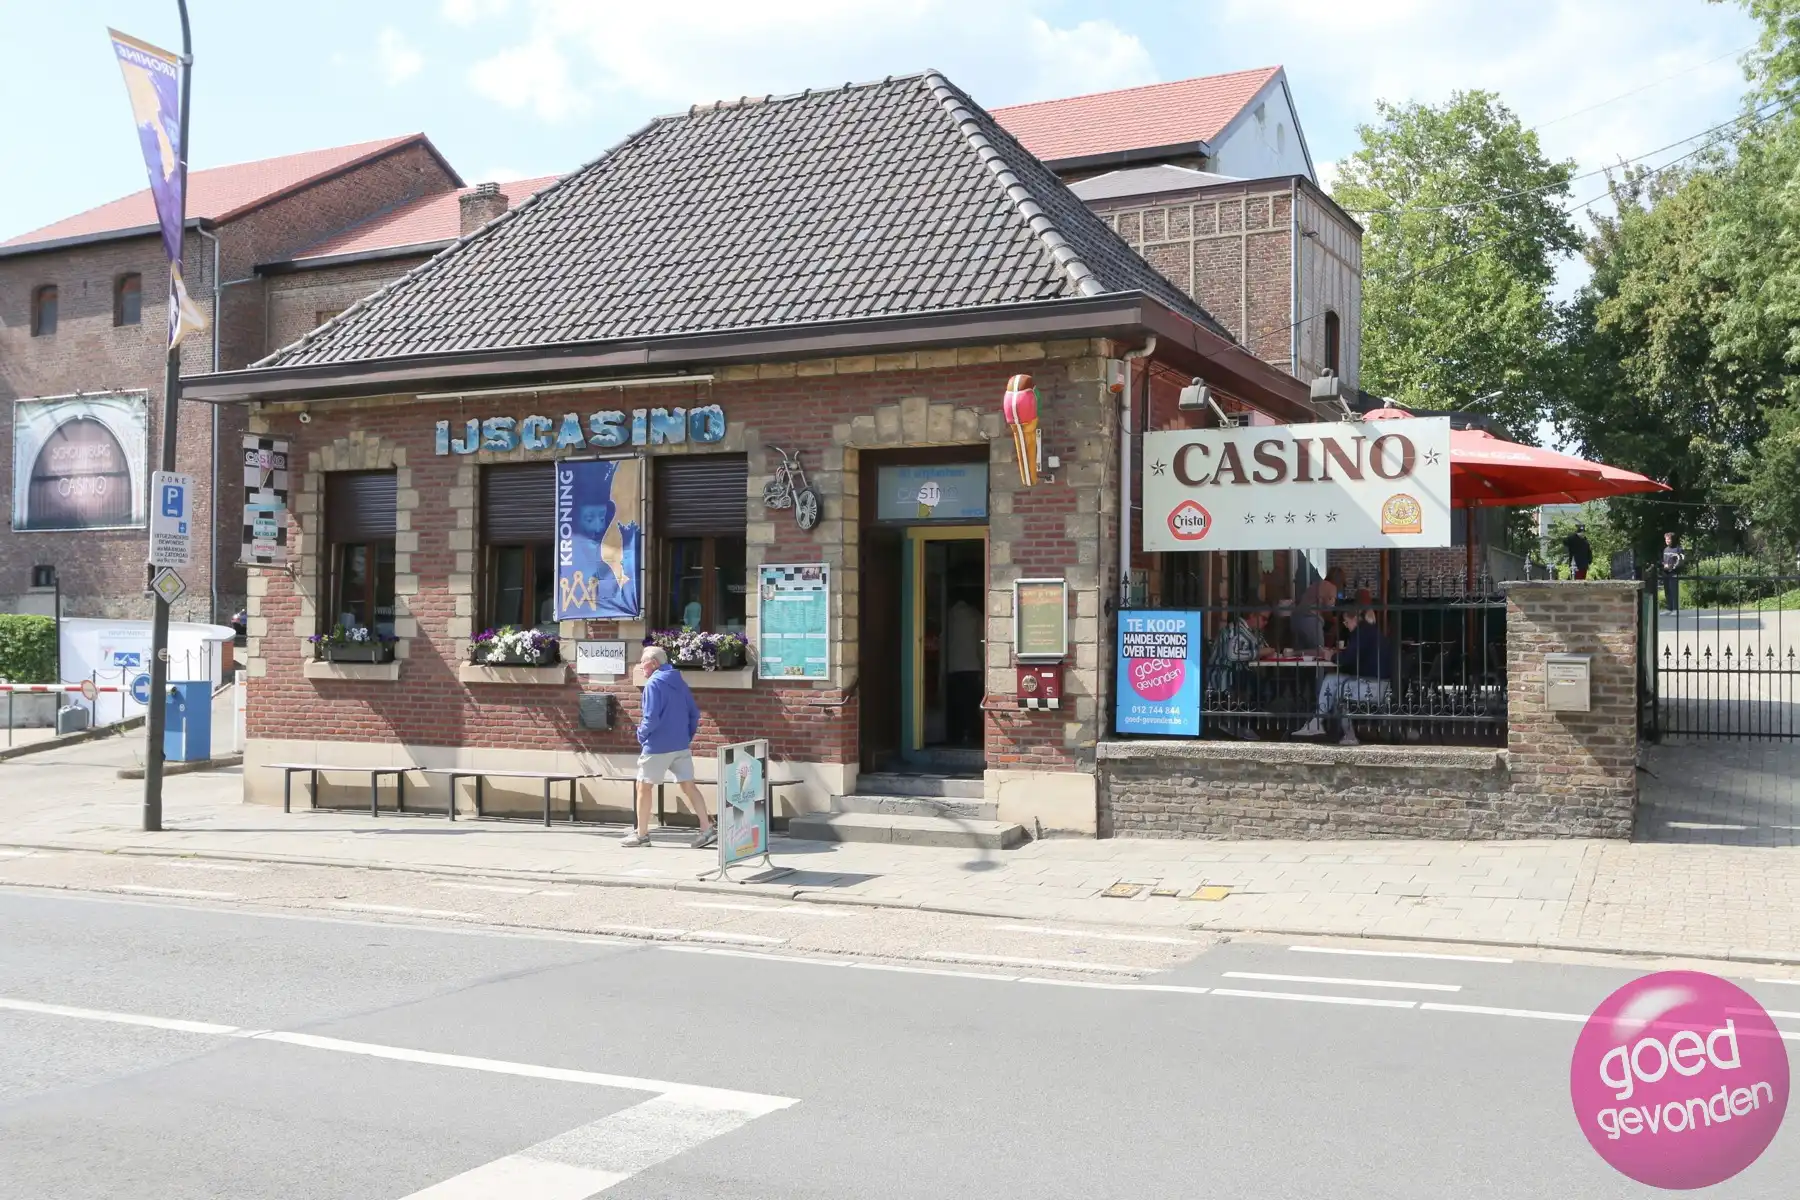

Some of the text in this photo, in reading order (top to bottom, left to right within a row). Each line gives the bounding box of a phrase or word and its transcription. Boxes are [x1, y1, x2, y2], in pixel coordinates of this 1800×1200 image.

[435, 404, 726, 456] IJSCASINO
[245, 451, 286, 466] CASINO
[1172, 433, 1416, 487] CASINO
[58, 476, 107, 497] CASINO
[160, 475, 187, 484] ZONE
[167, 487, 179, 505] P
[560, 470, 573, 566] KRONING
[1172, 514, 1206, 529] Cristal
[1127, 619, 1186, 633] TE KOOP
[1123, 633, 1187, 645] HANDELSFONDS
[579, 644, 624, 657] De Lekbank
[1123, 645, 1186, 658] OVER TE NEMEN
[1136, 668, 1182, 691] gevonden
[1131, 705, 1180, 714] 012 744 844
